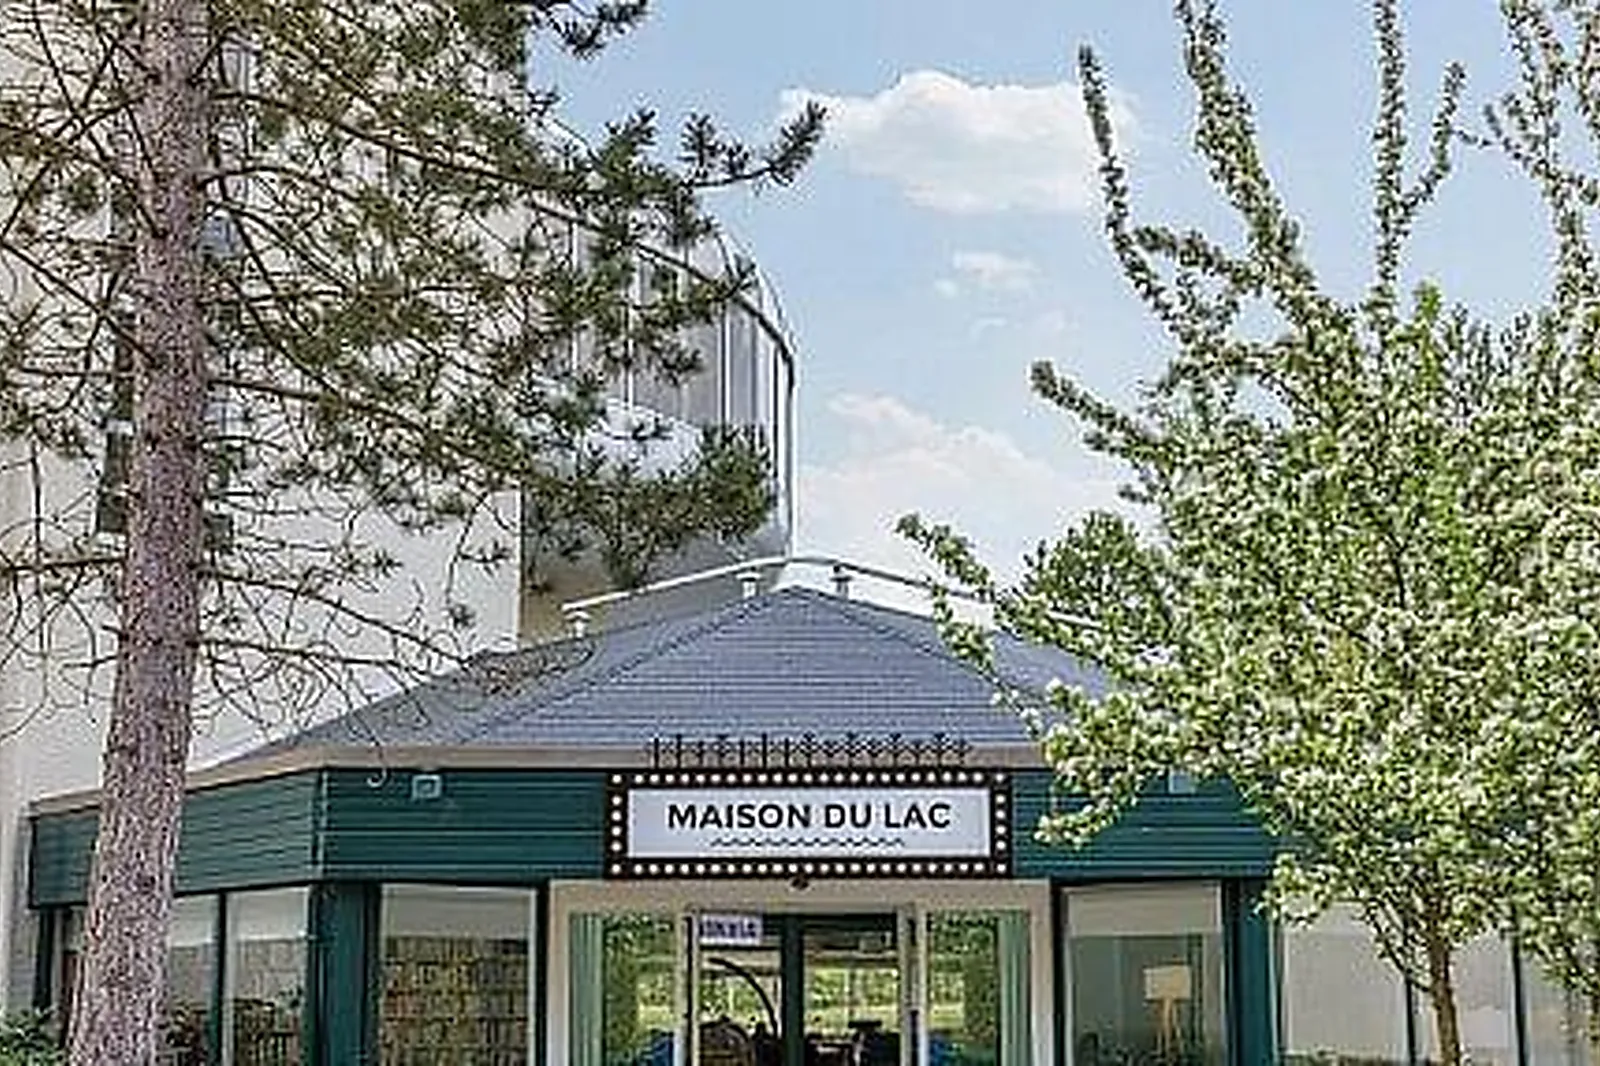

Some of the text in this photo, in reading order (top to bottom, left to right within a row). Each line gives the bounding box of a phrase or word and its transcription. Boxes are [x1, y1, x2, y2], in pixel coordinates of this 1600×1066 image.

[668, 802, 951, 828] MAISON DU LAC
